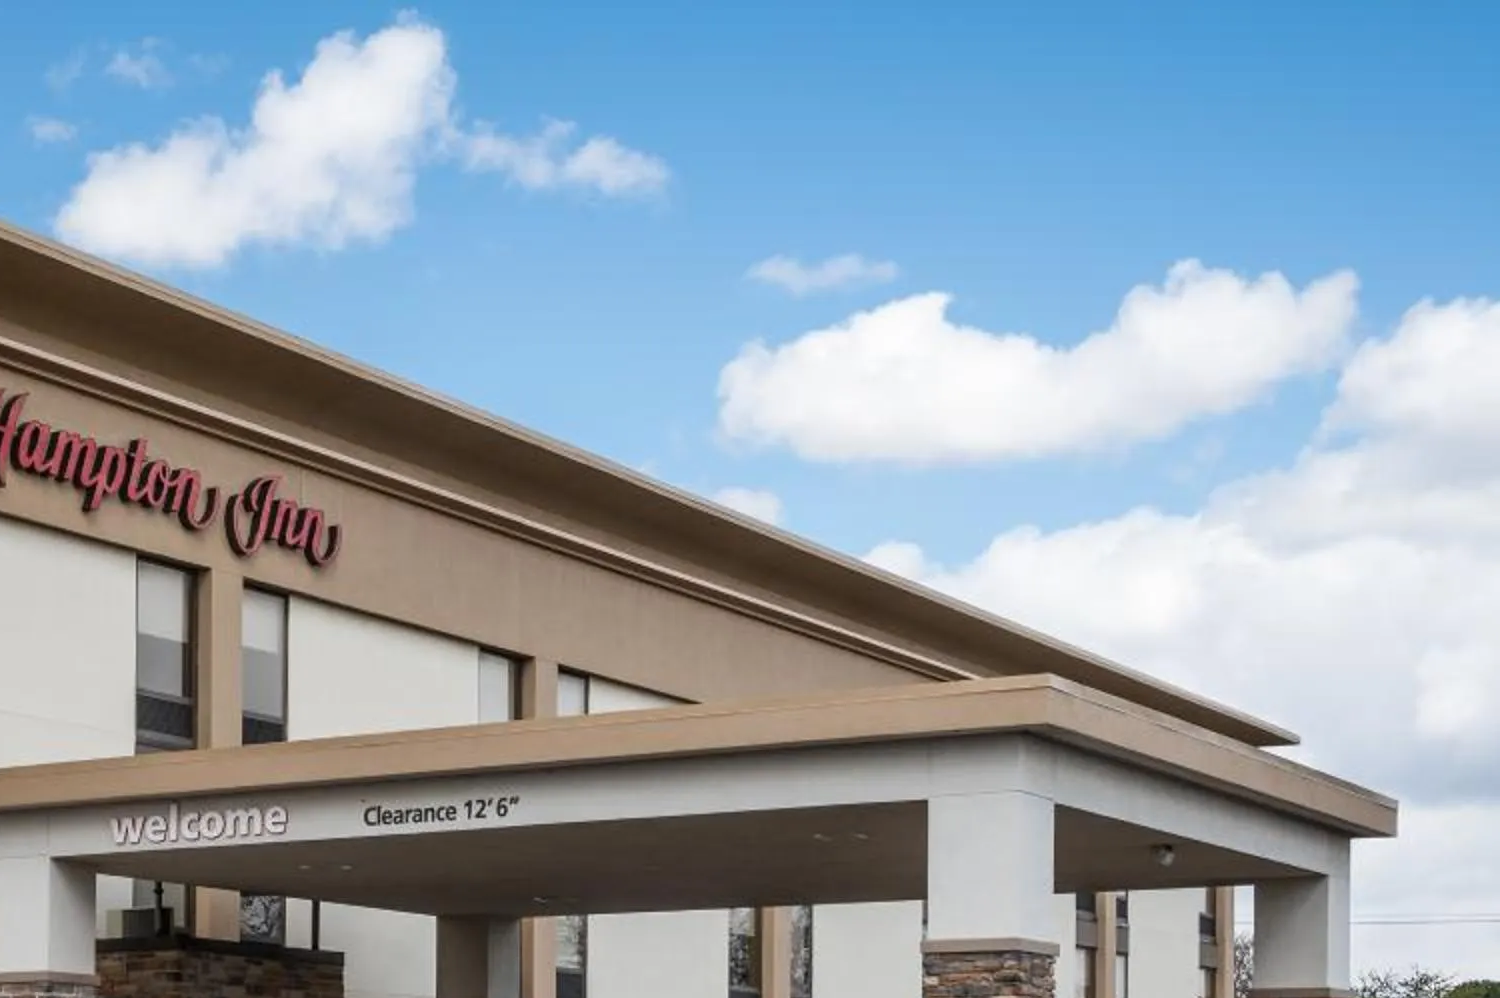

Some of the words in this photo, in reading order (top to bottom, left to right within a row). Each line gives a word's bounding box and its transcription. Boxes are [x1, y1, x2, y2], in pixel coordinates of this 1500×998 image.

[225, 473, 342, 567] Inn
[110, 802, 288, 845] welcome
[363, 804, 457, 827] Clearance
